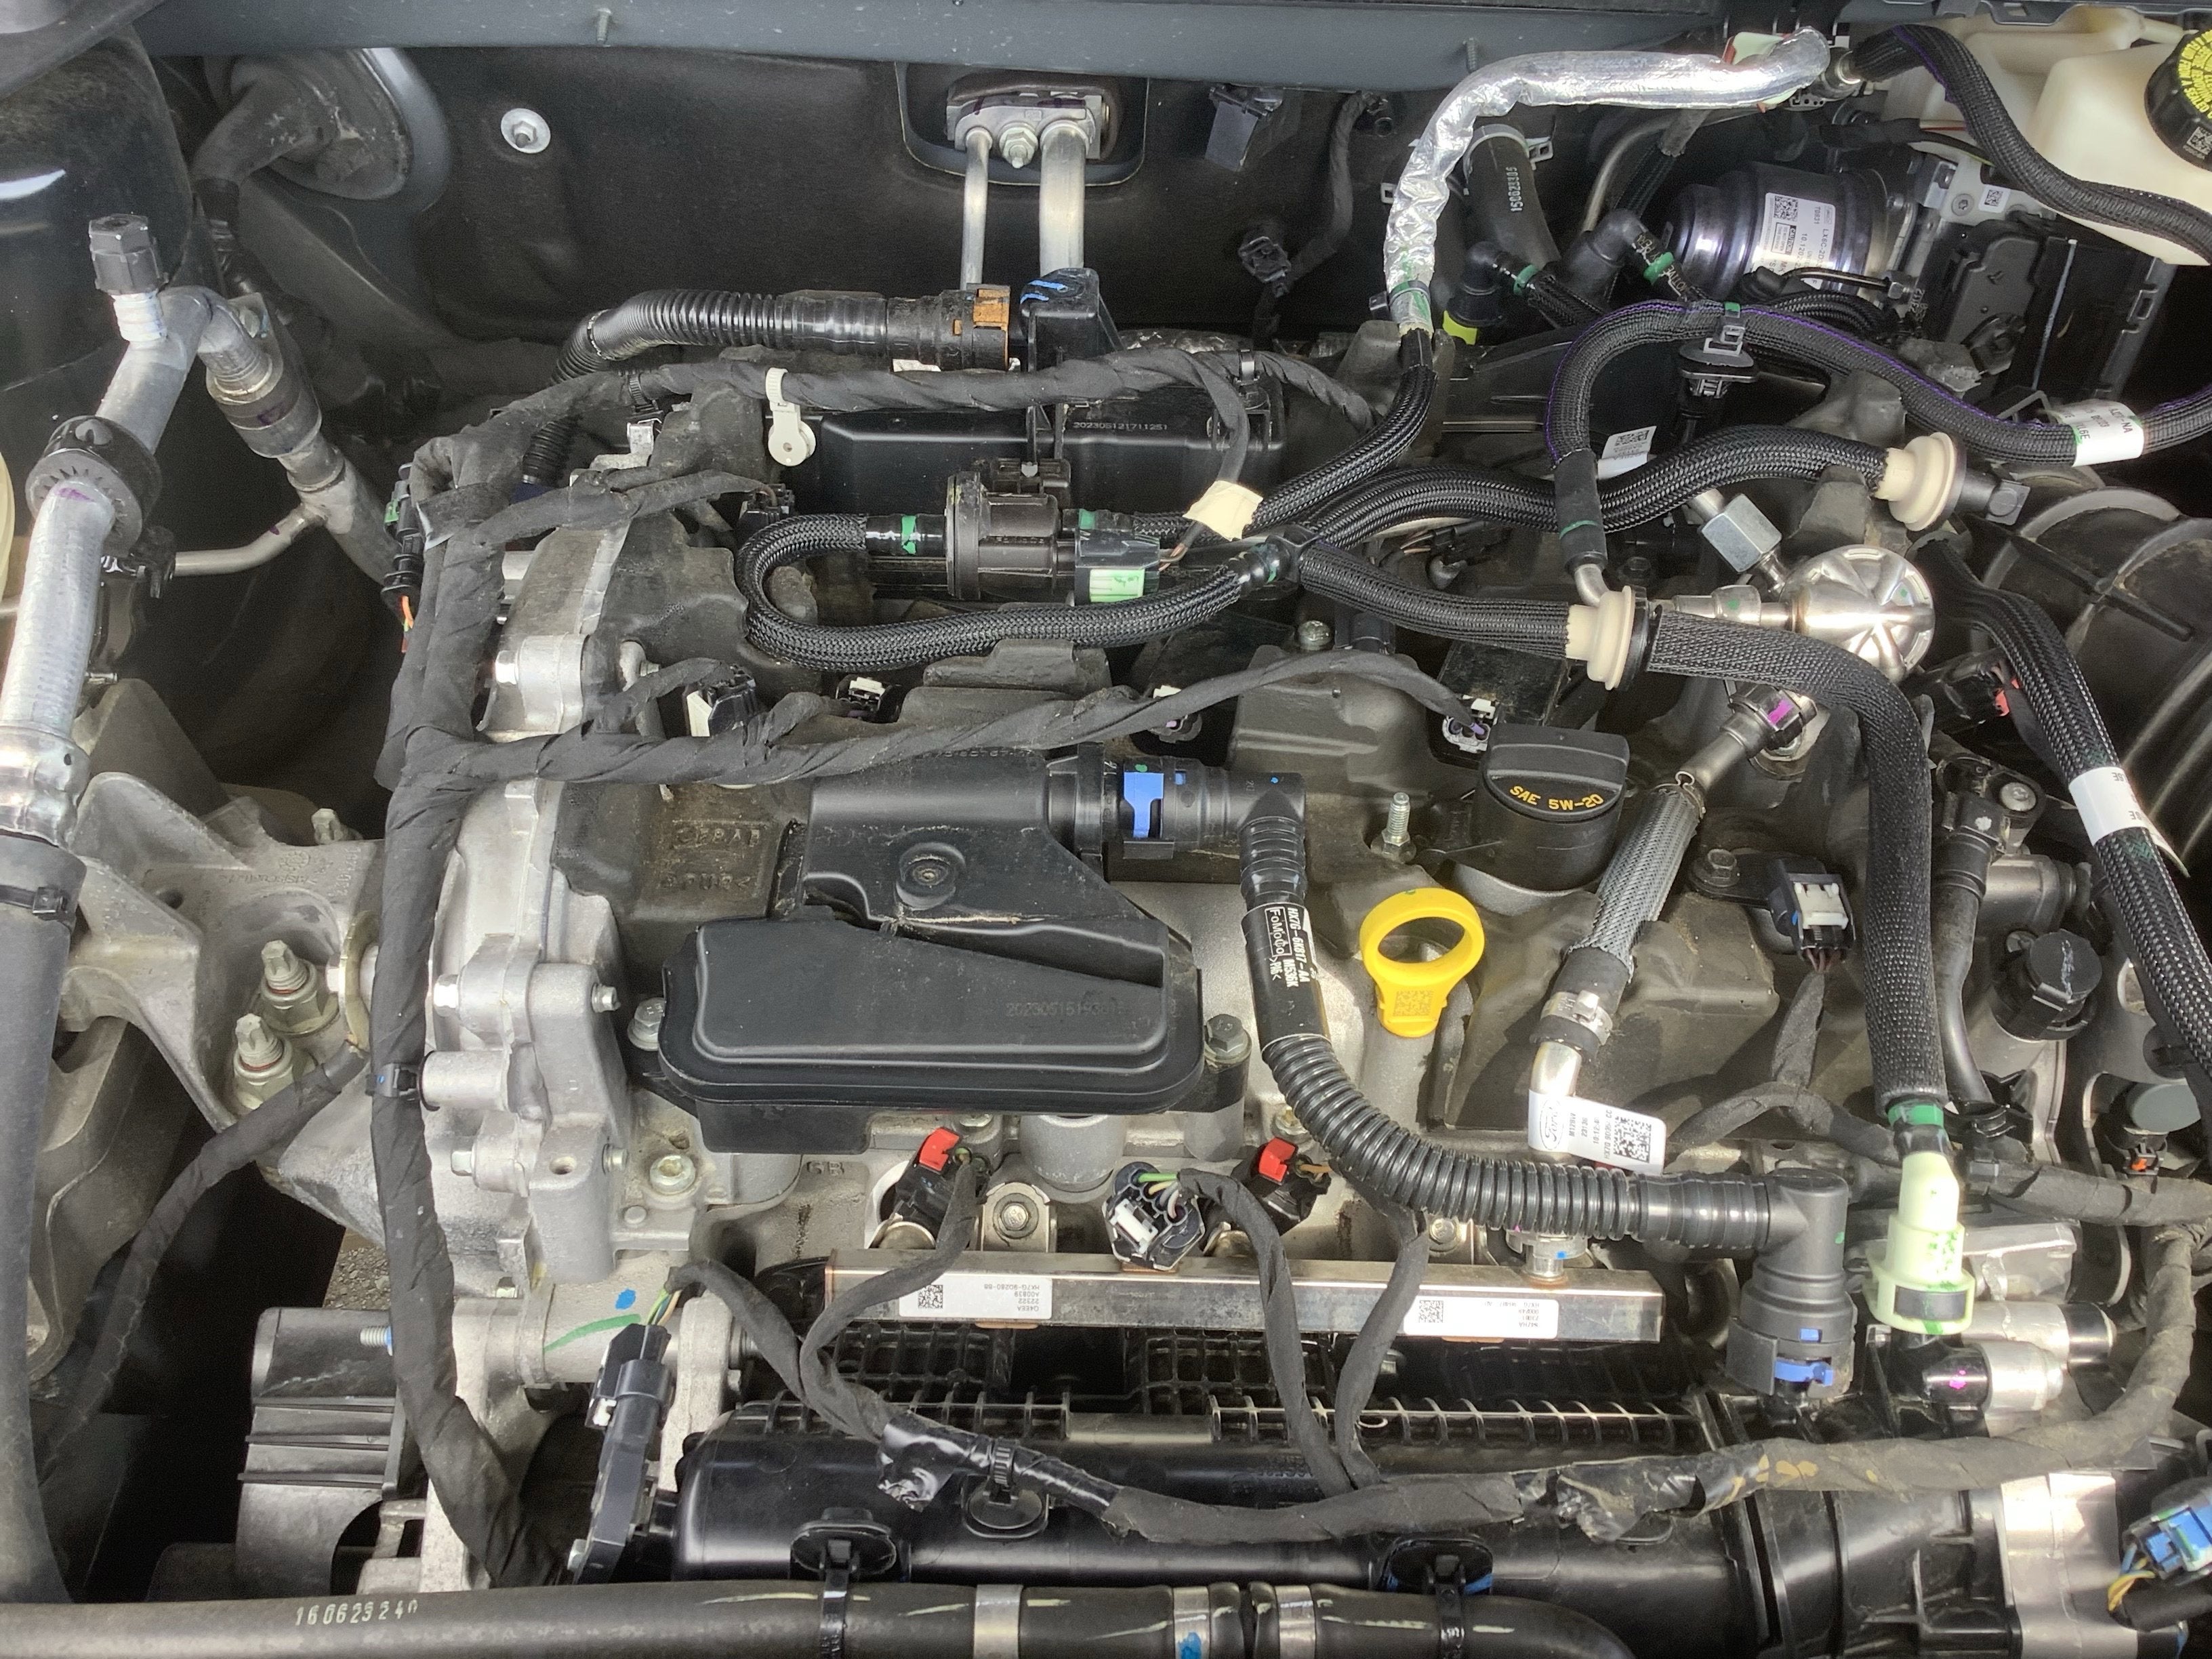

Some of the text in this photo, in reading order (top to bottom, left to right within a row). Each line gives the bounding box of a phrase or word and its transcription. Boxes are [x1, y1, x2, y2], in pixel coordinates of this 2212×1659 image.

[2184, 87, 2209, 112] SEALED
[1786, 226, 1797, 255] CAUTION
[1509, 785, 1605, 811] SAE 5W-20
[1269, 909, 1285, 954] FoMoCo
[1287, 907, 1311, 983] HX7G-6K817-AA
[1282, 958, 1299, 988] M536K
